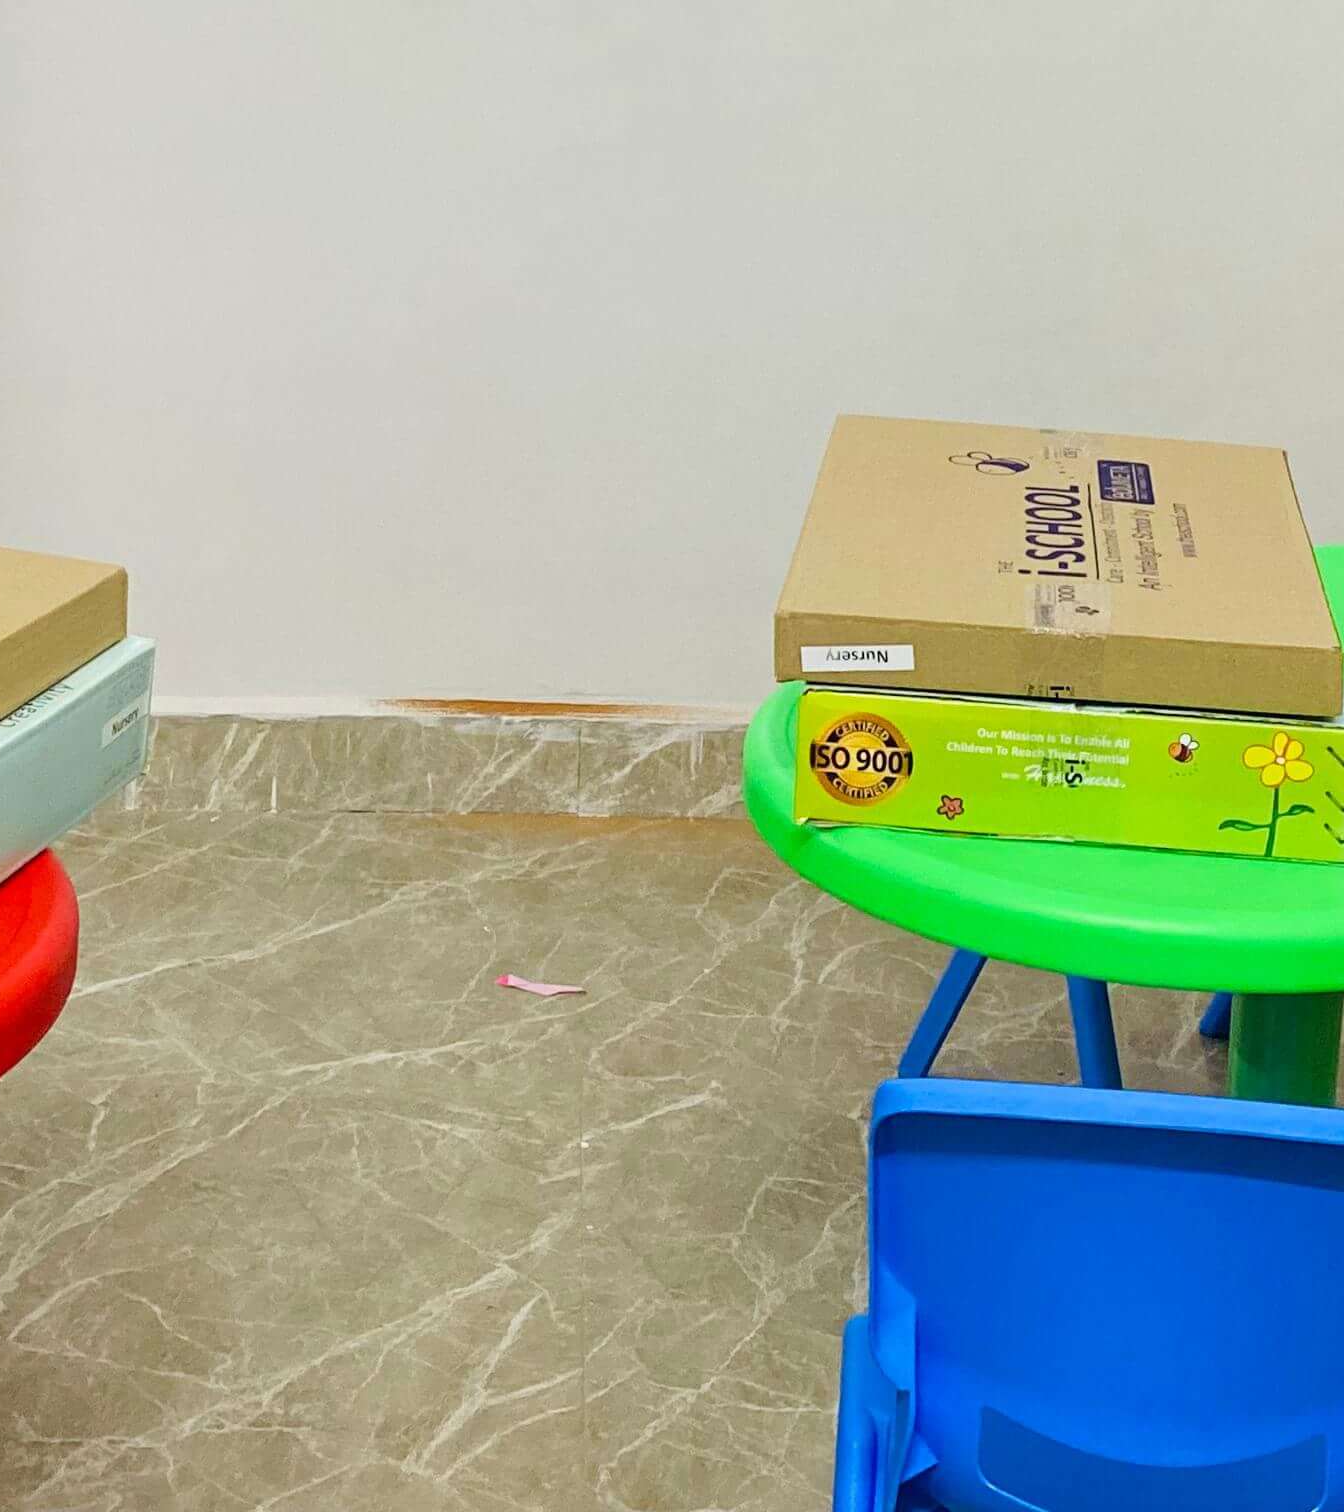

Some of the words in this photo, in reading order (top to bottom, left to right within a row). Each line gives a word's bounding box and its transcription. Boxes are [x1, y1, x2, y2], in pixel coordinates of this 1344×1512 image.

[1017, 485, 1088, 579] i-SCHOOL
[825, 648, 889, 665] Nursery
[835, 719, 890, 743] CERTIFIED
[976, 727, 999, 739] Our
[1000, 730, 1045, 743] Mission
[1059, 734, 1073, 745] To
[1074, 734, 1114, 748] Enable
[1114, 737, 1131, 750] All
[809, 742, 851, 771] ISO
[856, 749, 914, 778] 9001
[946, 741, 993, 755] Children
[996, 744, 1009, 756] To
[1011, 746, 1045, 759] Reach
[1078, 751, 1130, 766] Potential
[832, 776, 890, 800] CERTIFIED
